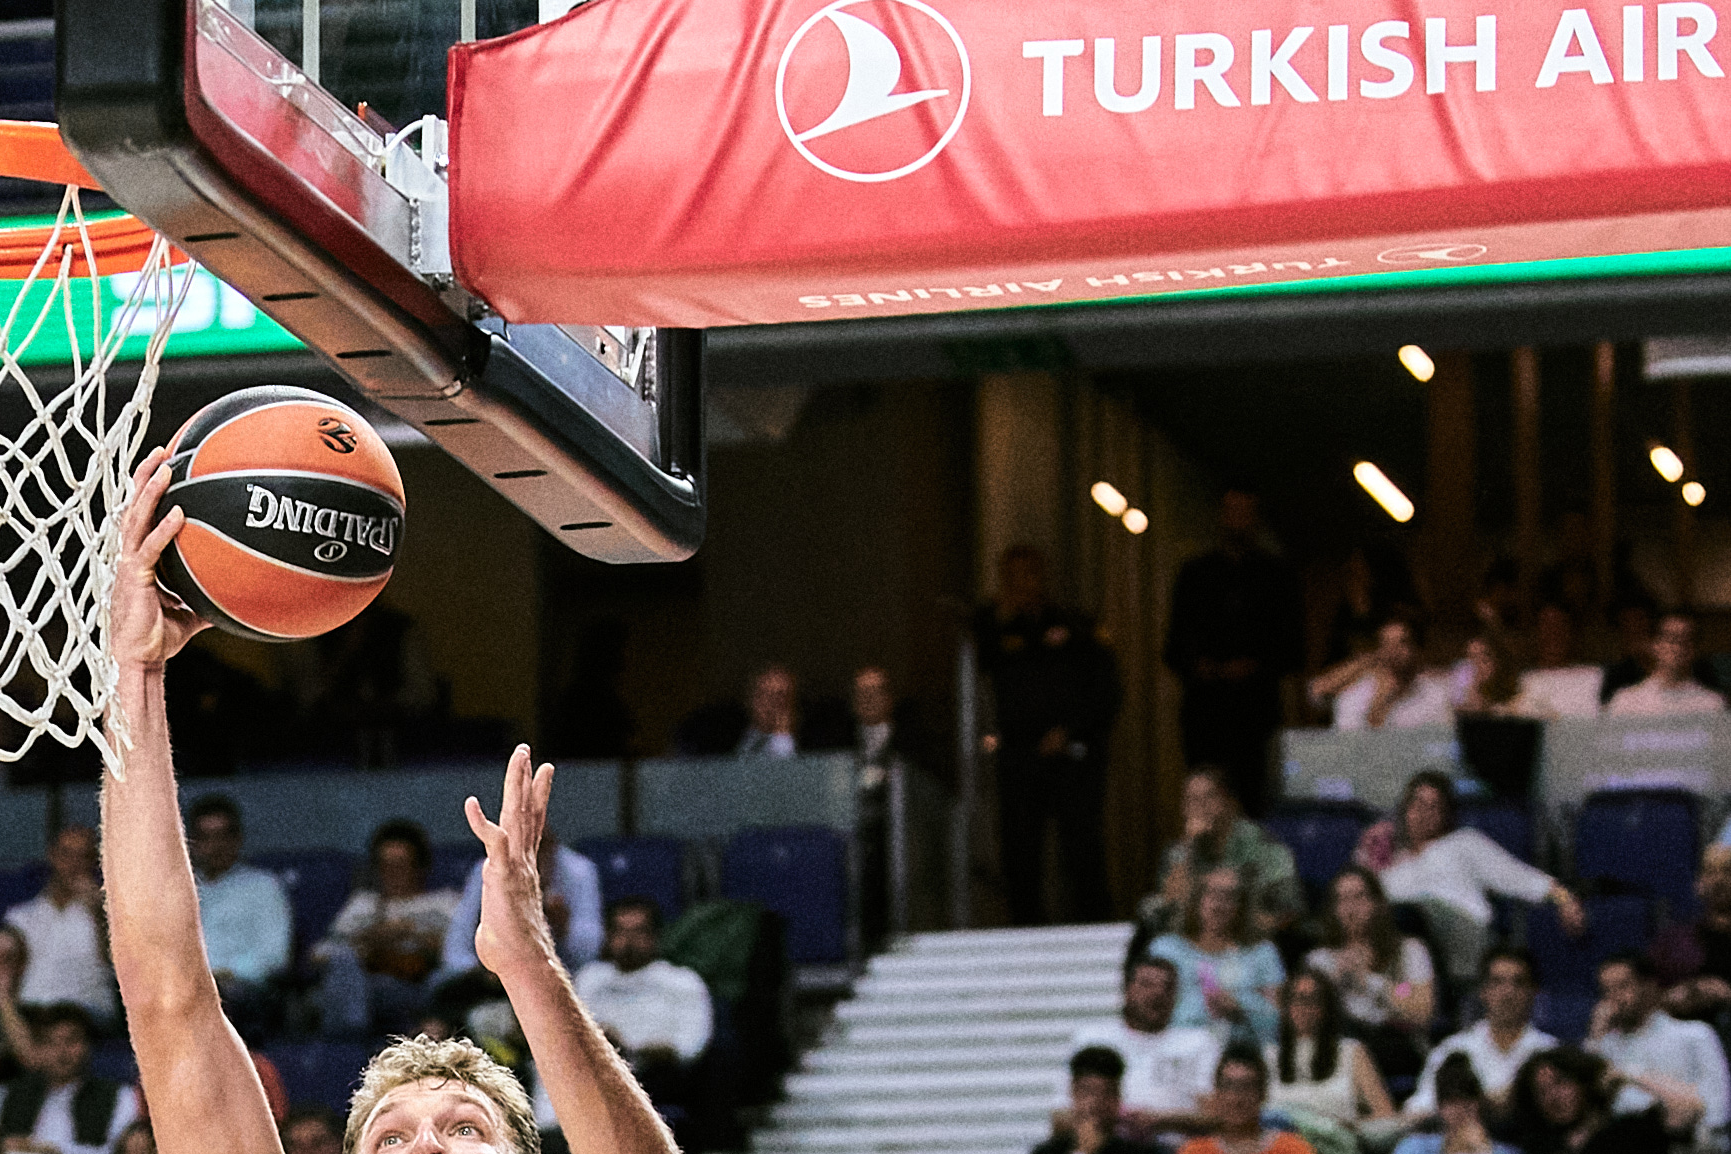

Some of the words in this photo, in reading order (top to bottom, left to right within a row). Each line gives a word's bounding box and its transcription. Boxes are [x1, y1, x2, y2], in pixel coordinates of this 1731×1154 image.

[1022, 14, 1498, 117] TURKISH
[1534, 2, 1726, 89] AIR
[798, 278, 1063, 308] AIRLINES
[1085, 256, 1351, 287] TURKISH
[245, 484, 399, 556] SPALDING
